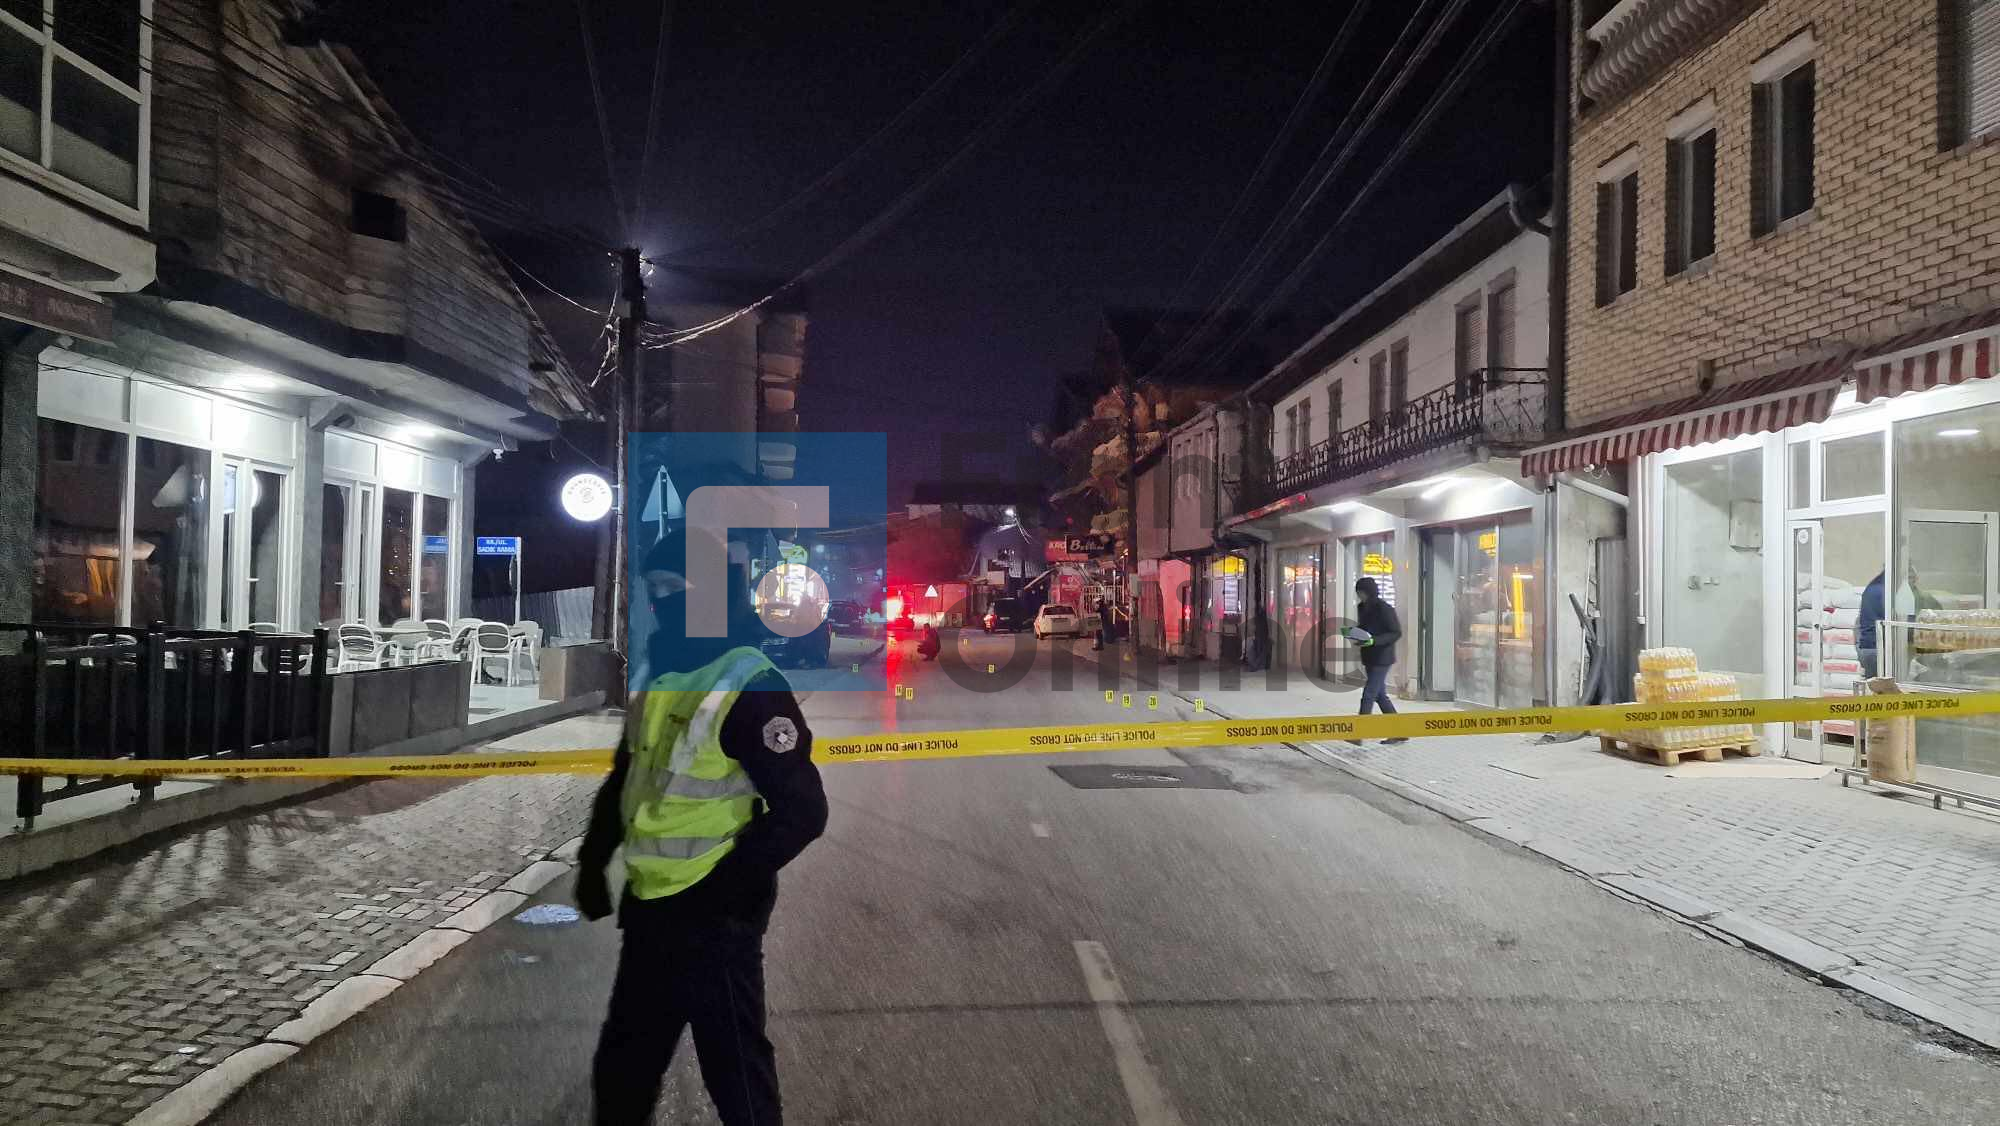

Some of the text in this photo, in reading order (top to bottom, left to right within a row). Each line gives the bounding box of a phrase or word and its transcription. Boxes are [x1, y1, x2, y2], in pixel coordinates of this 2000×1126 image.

[1830, 703, 1861, 713] CROSS
[1865, 702, 1883, 712] NOT
[1886, 702, 1899, 711] DO
[1902, 700, 1923, 710] LINE
[1625, 707, 1755, 721] POLICE LINE DO NOT CROSS
[1425, 715, 1552, 730] POLICE LINE DO NOT CROSS
[1226, 722, 1353, 737] POLICE LINE DO NOT CROSS
[1030, 735, 1060, 745] CROSS
[1064, 734, 1082, 744] NOT
[1123, 730, 1155, 740] POLICE
[829, 739, 958, 755] POLICE LINE DO NOT CROSS
